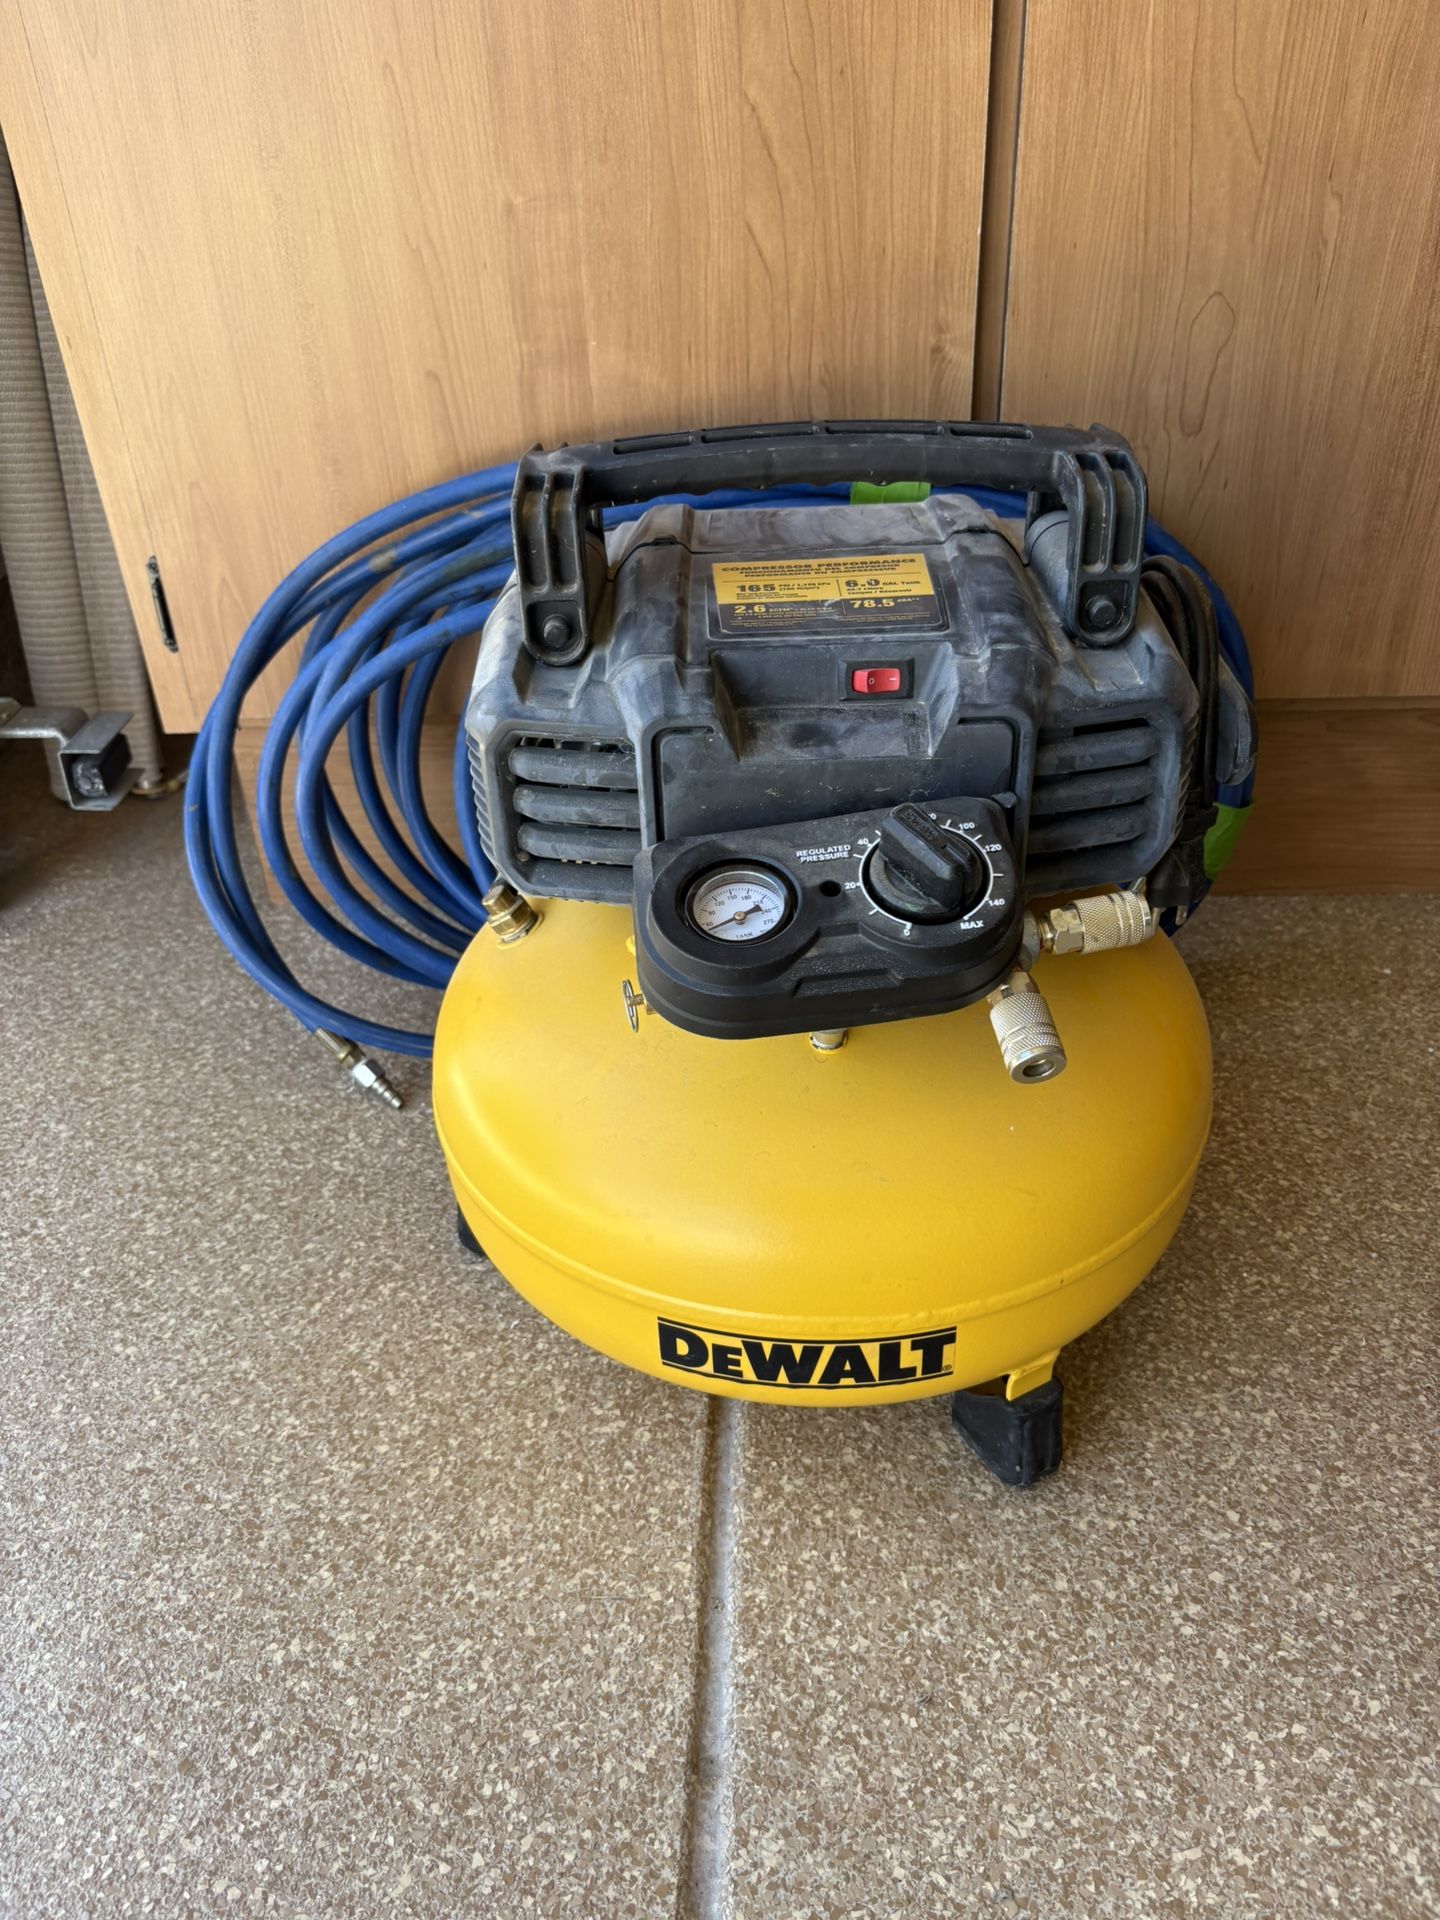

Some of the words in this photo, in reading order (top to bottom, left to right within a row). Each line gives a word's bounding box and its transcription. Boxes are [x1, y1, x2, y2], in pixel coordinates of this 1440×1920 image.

[721, 564, 812, 572] COMPRESSOR
[817, 558, 916, 568] PERFORMANCE
[736, 583, 776, 593] 165
[844, 578, 880, 588] 6.0
[850, 598, 895, 609] 78.5
[734, 604, 767, 614] 2.6
[958, 821, 976, 831] 100
[857, 838, 869, 846] 40
[796, 844, 851, 858] REGULATED
[986, 843, 1002, 852] 120
[800, 851, 850, 864] PRESSURE
[844, 881, 856, 890] 20
[988, 898, 1006, 908] 140
[959, 920, 984, 931] MAX
[903, 928, 911, 937] 0
